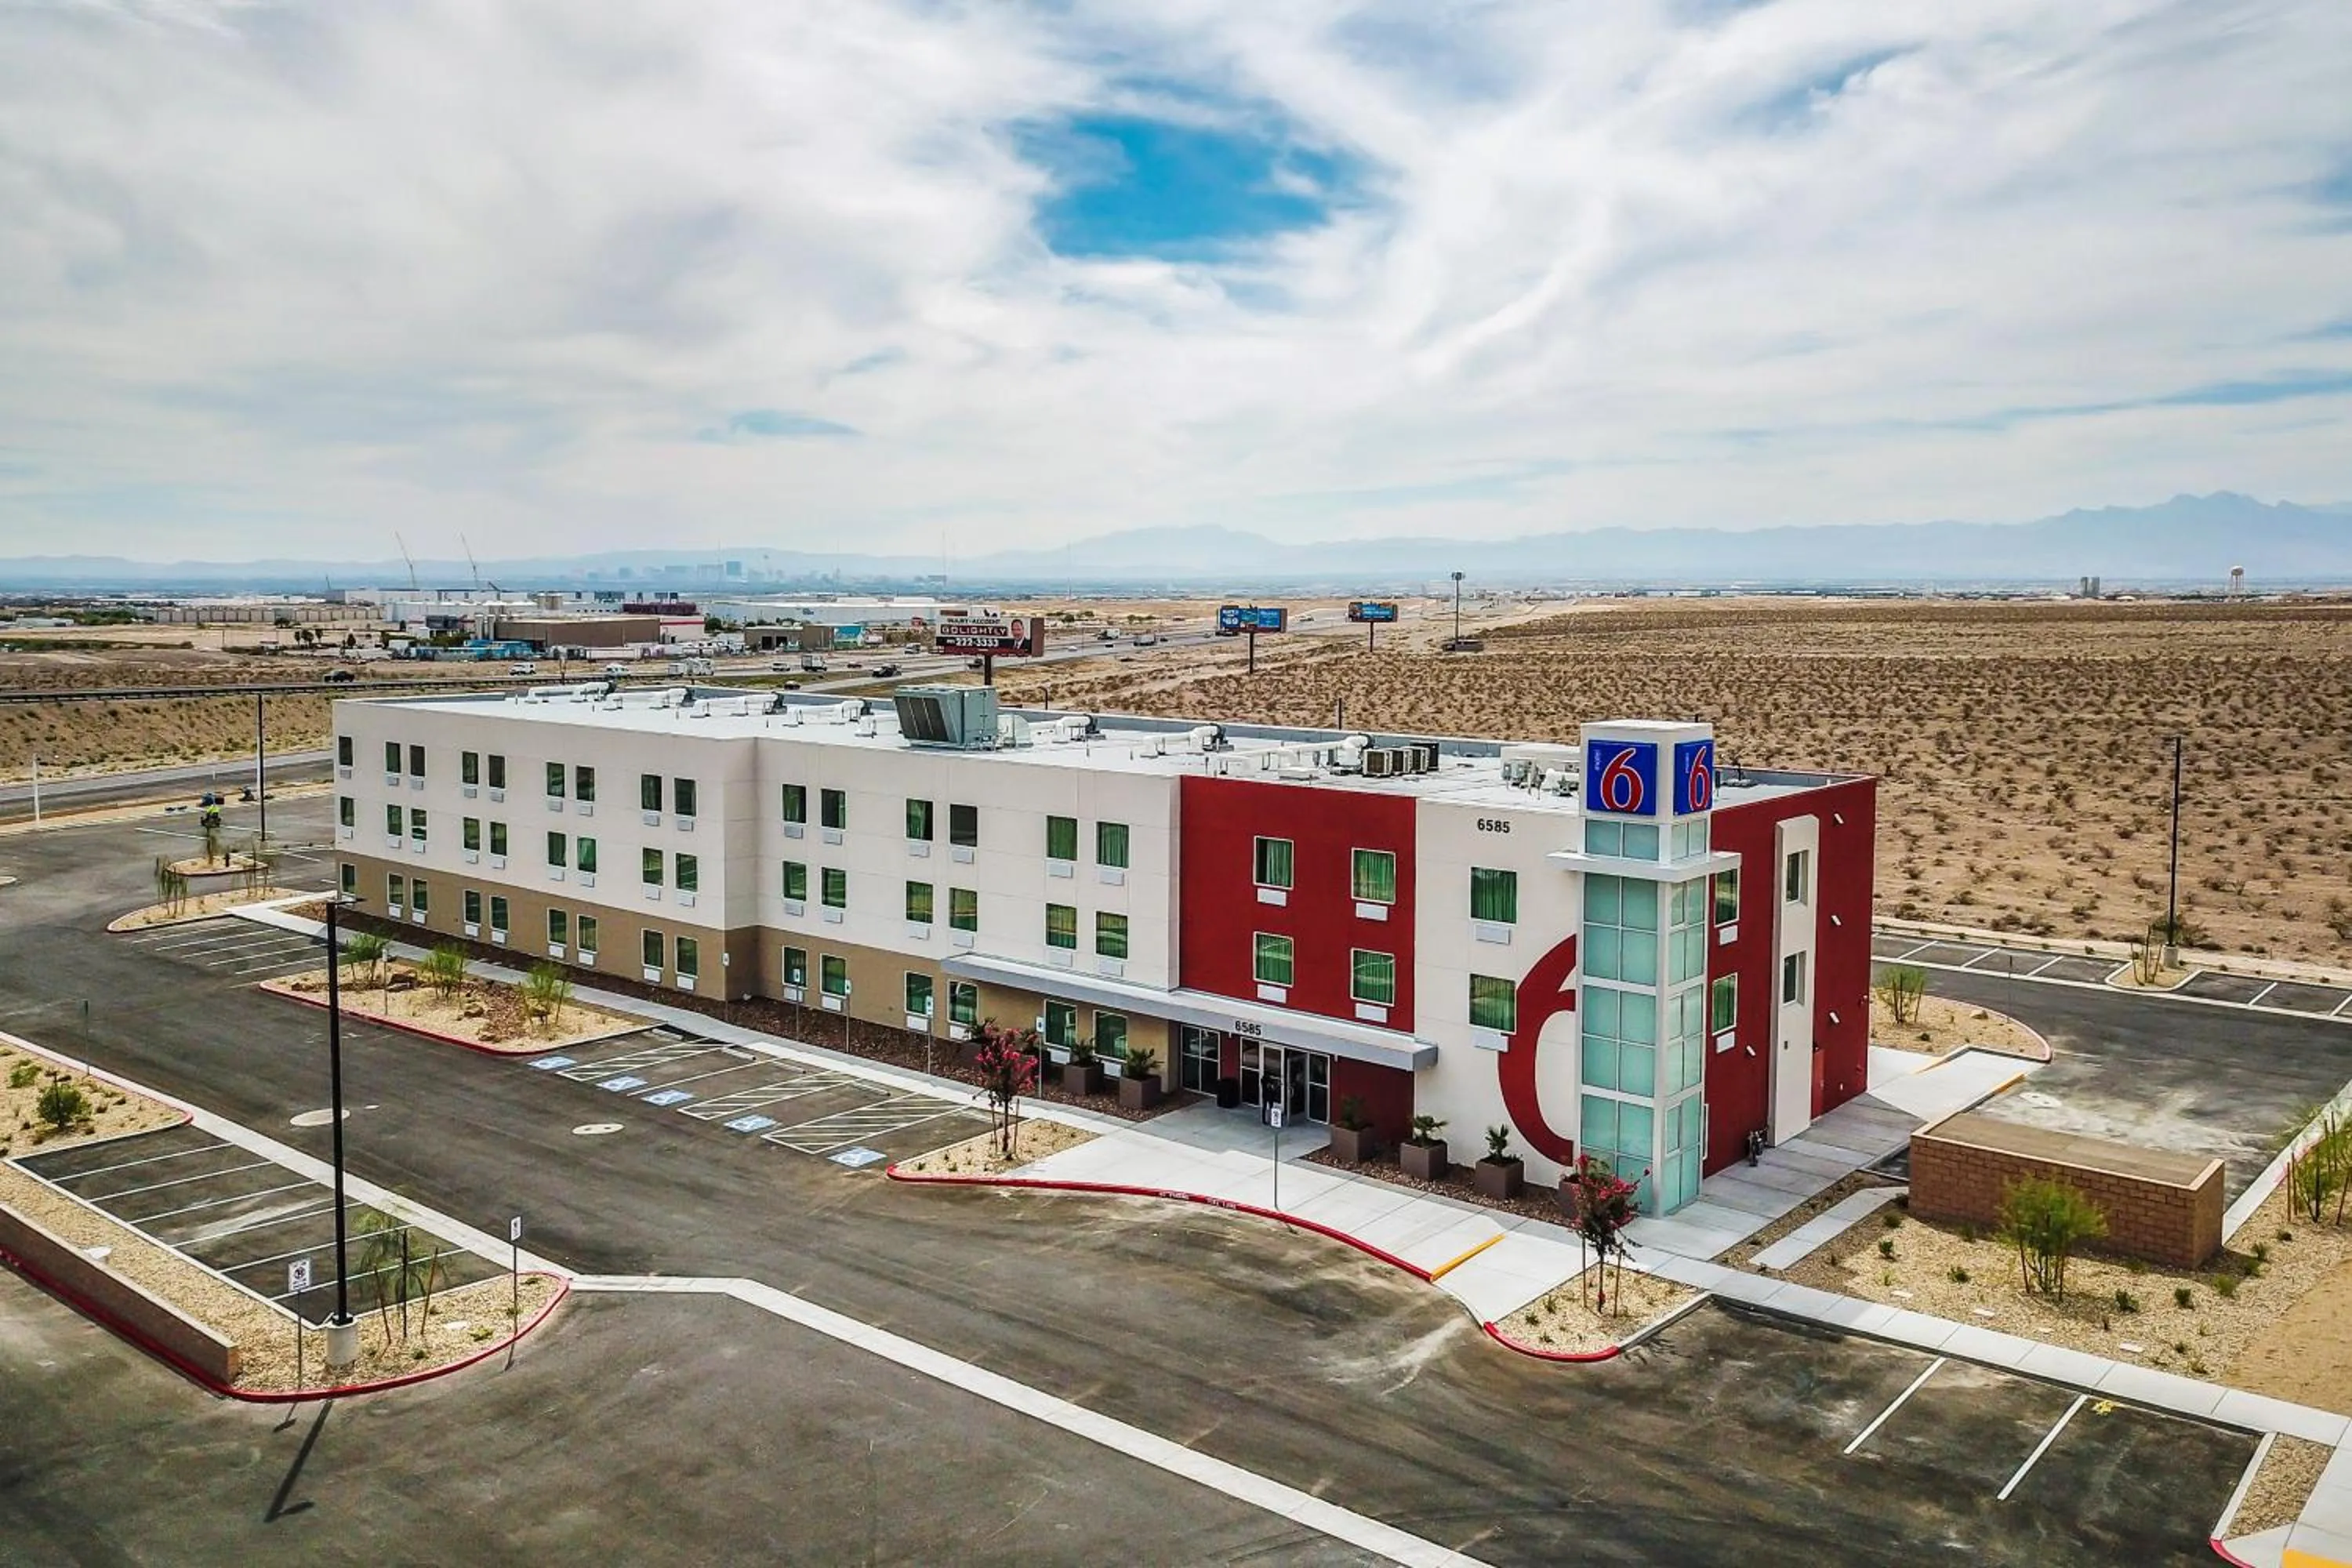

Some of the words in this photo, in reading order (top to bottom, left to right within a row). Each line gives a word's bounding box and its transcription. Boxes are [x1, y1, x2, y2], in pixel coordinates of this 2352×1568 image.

[1601, 747, 1644, 812] 6
[1689, 746, 1711, 811] 6
[1477, 818, 1510, 833] 6585
